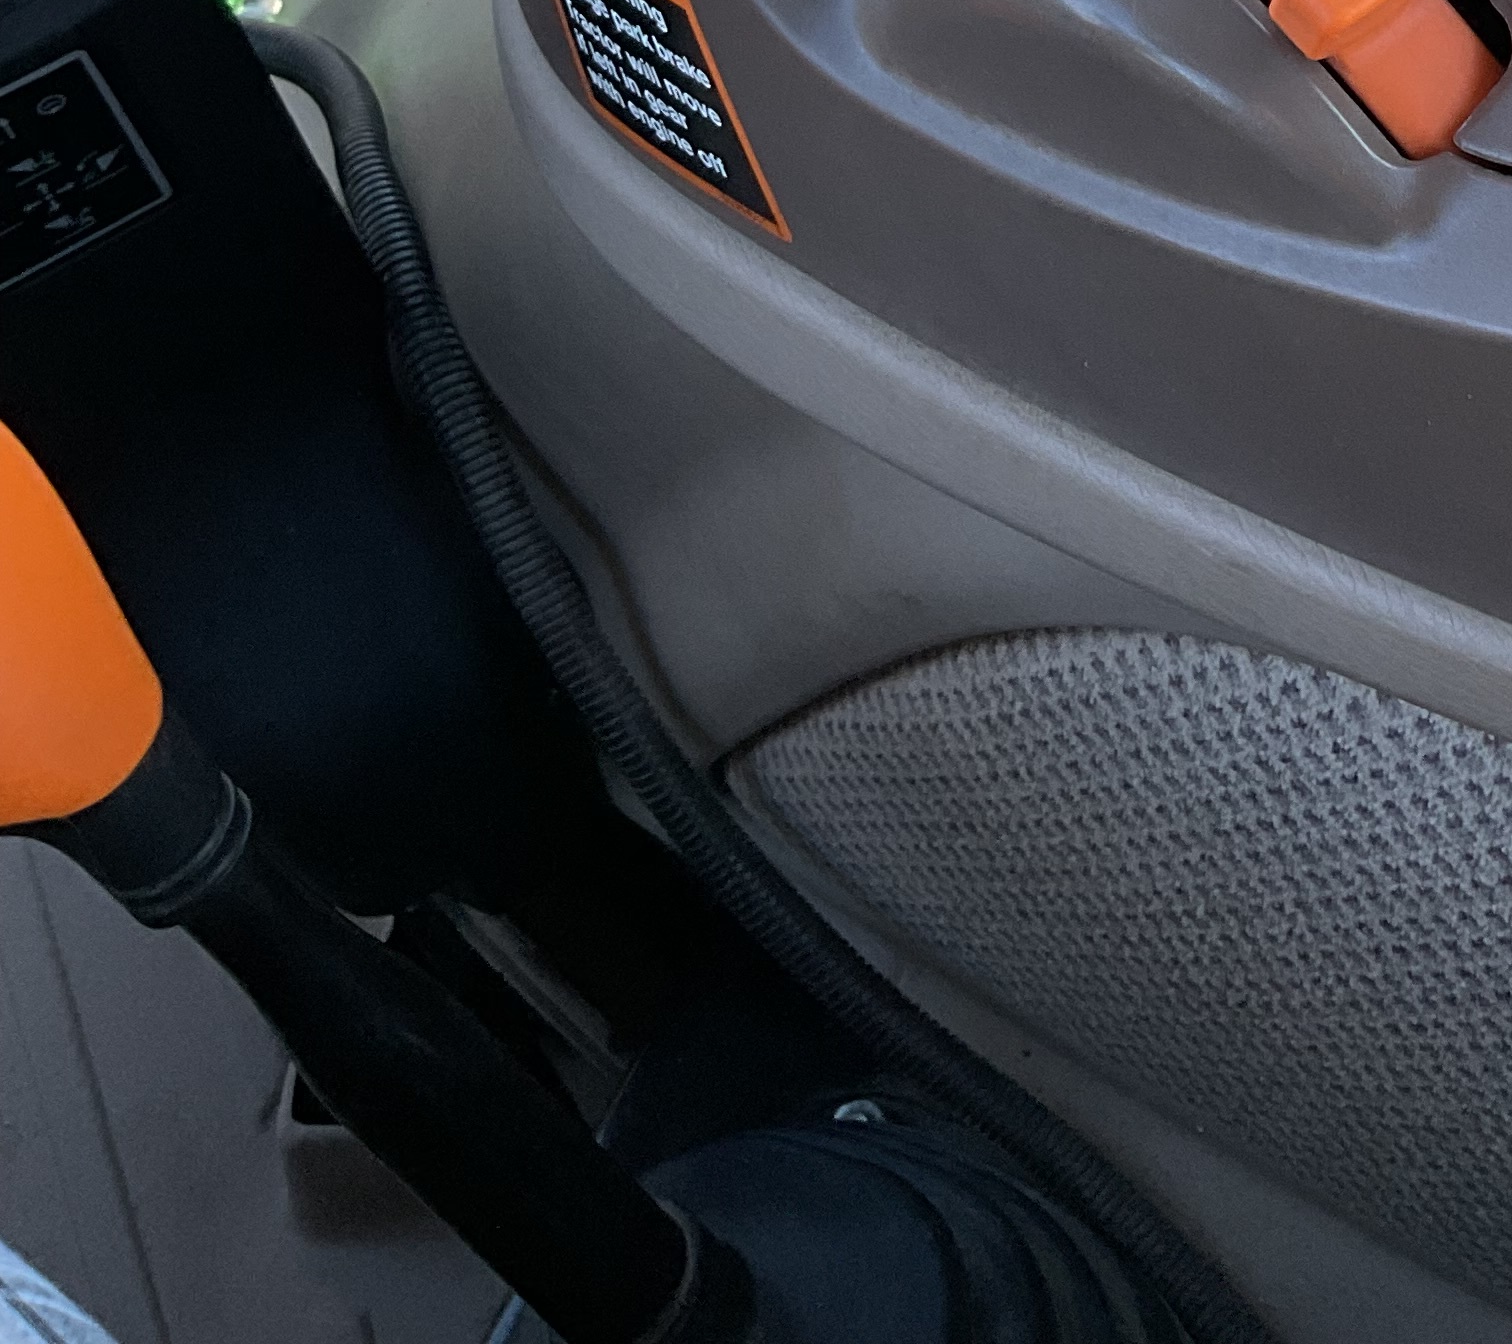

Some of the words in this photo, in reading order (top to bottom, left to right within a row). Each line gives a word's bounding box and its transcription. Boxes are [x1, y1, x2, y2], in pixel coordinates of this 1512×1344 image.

[588, 41, 620, 82] left
[620, 66, 642, 98] in
[644, 89, 688, 130] gear
[611, 9, 654, 52] park
[652, 35, 712, 89] brake
[625, 51, 662, 88] will
[663, 78, 722, 127] move
[586, 65, 626, 109] with
[627, 100, 694, 157] engine
[698, 149, 728, 179] off
